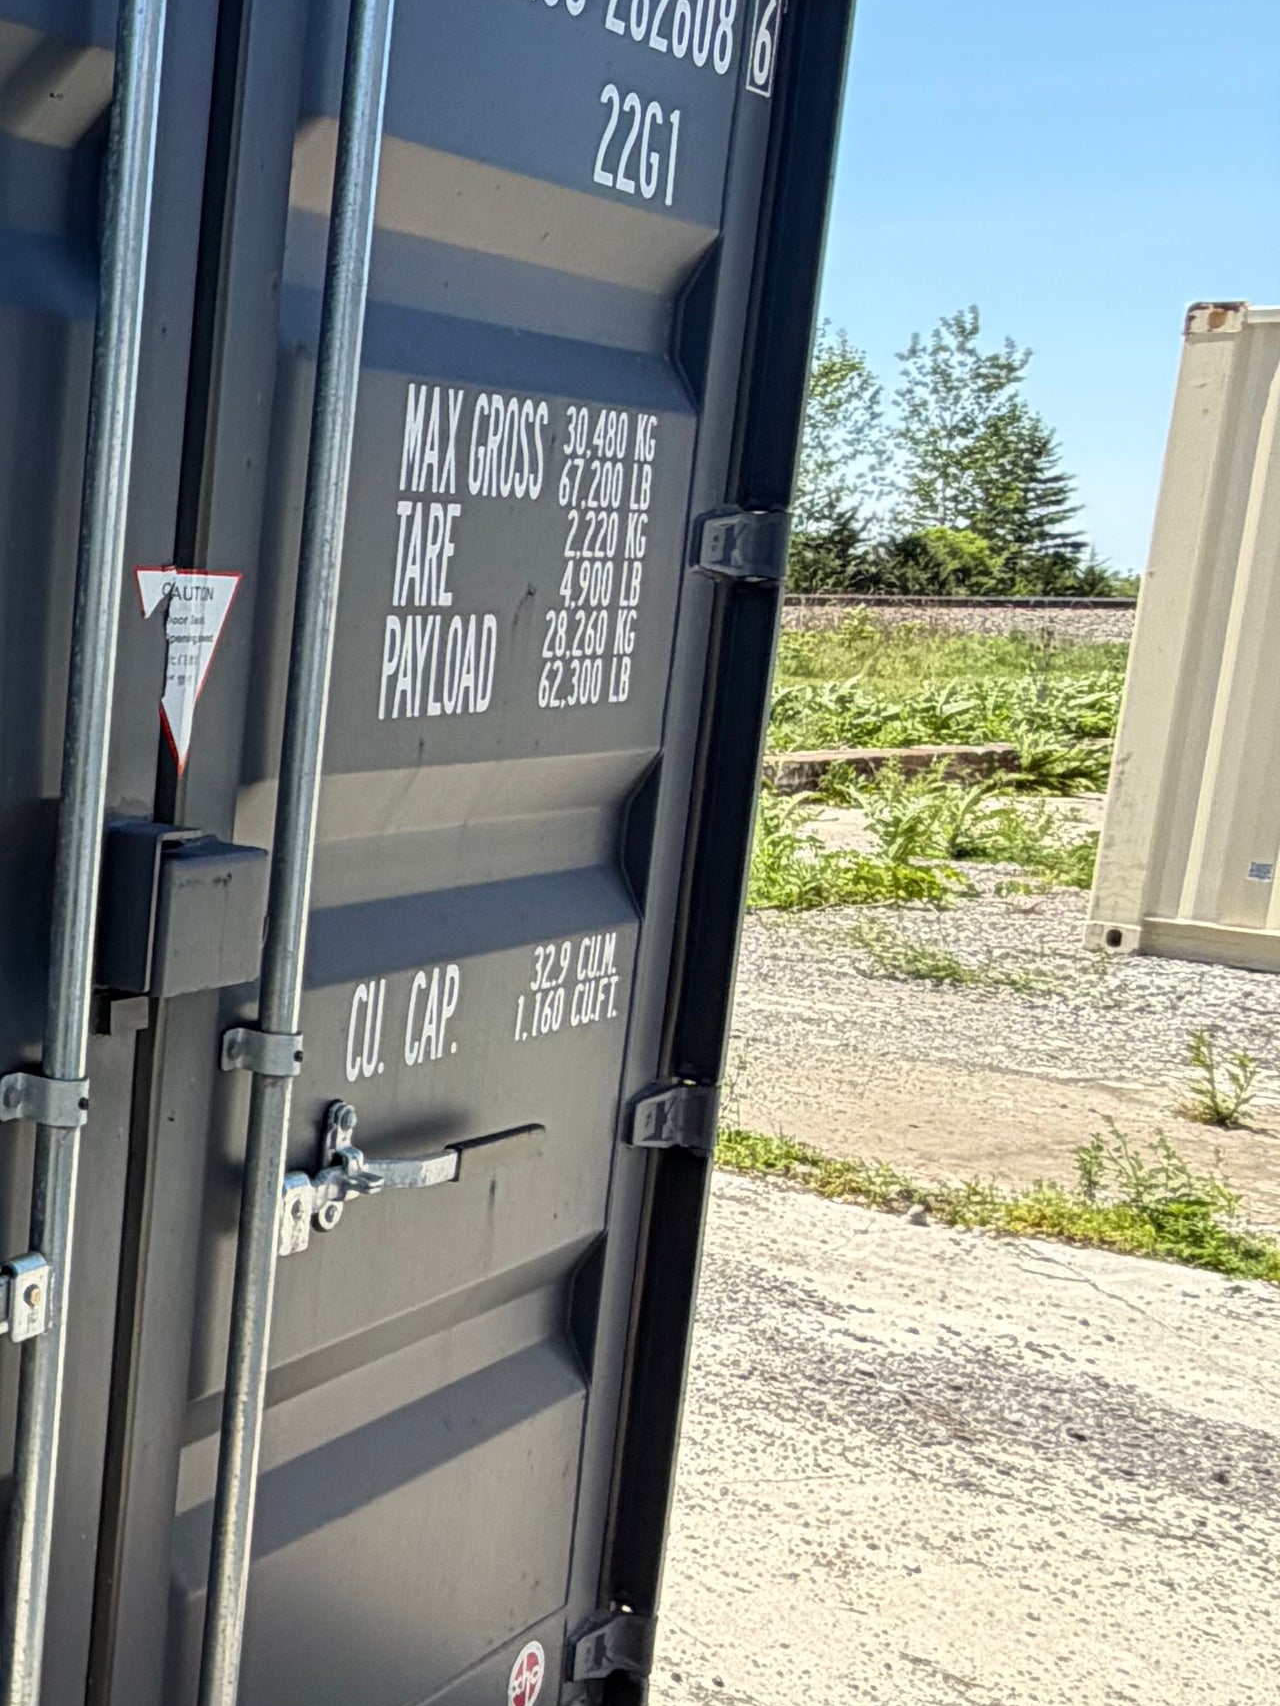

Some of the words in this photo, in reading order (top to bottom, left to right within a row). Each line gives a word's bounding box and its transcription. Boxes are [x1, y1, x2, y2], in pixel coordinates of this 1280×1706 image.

[593, 83, 681, 207] 22G1
[399, 383, 464, 494] MAX
[467, 392, 549, 500] GROSS
[563, 405, 628, 460] 30,480
[634, 413, 658, 462] KG
[558, 457, 625, 510] 67,200
[629, 463, 652, 512] LB
[392, 500, 462, 607] TARE
[564, 510, 619, 560] 2,220
[624, 512, 648, 560] KG
[559, 560, 615, 611] 4,900
[619, 561, 642, 608] LB
[378, 613, 498, 721] PAYLOAD
[542, 609, 608, 660] 28,260
[613, 609, 638, 655] KG
[538, 657, 604, 710] 62,300
[608, 656, 632, 703] LB
[345, 979, 386, 1082] CU.
[404, 964, 460, 1066] CAP.
[530, 940, 572, 992] 32.9
[515, 986, 566, 1042] 1,160
